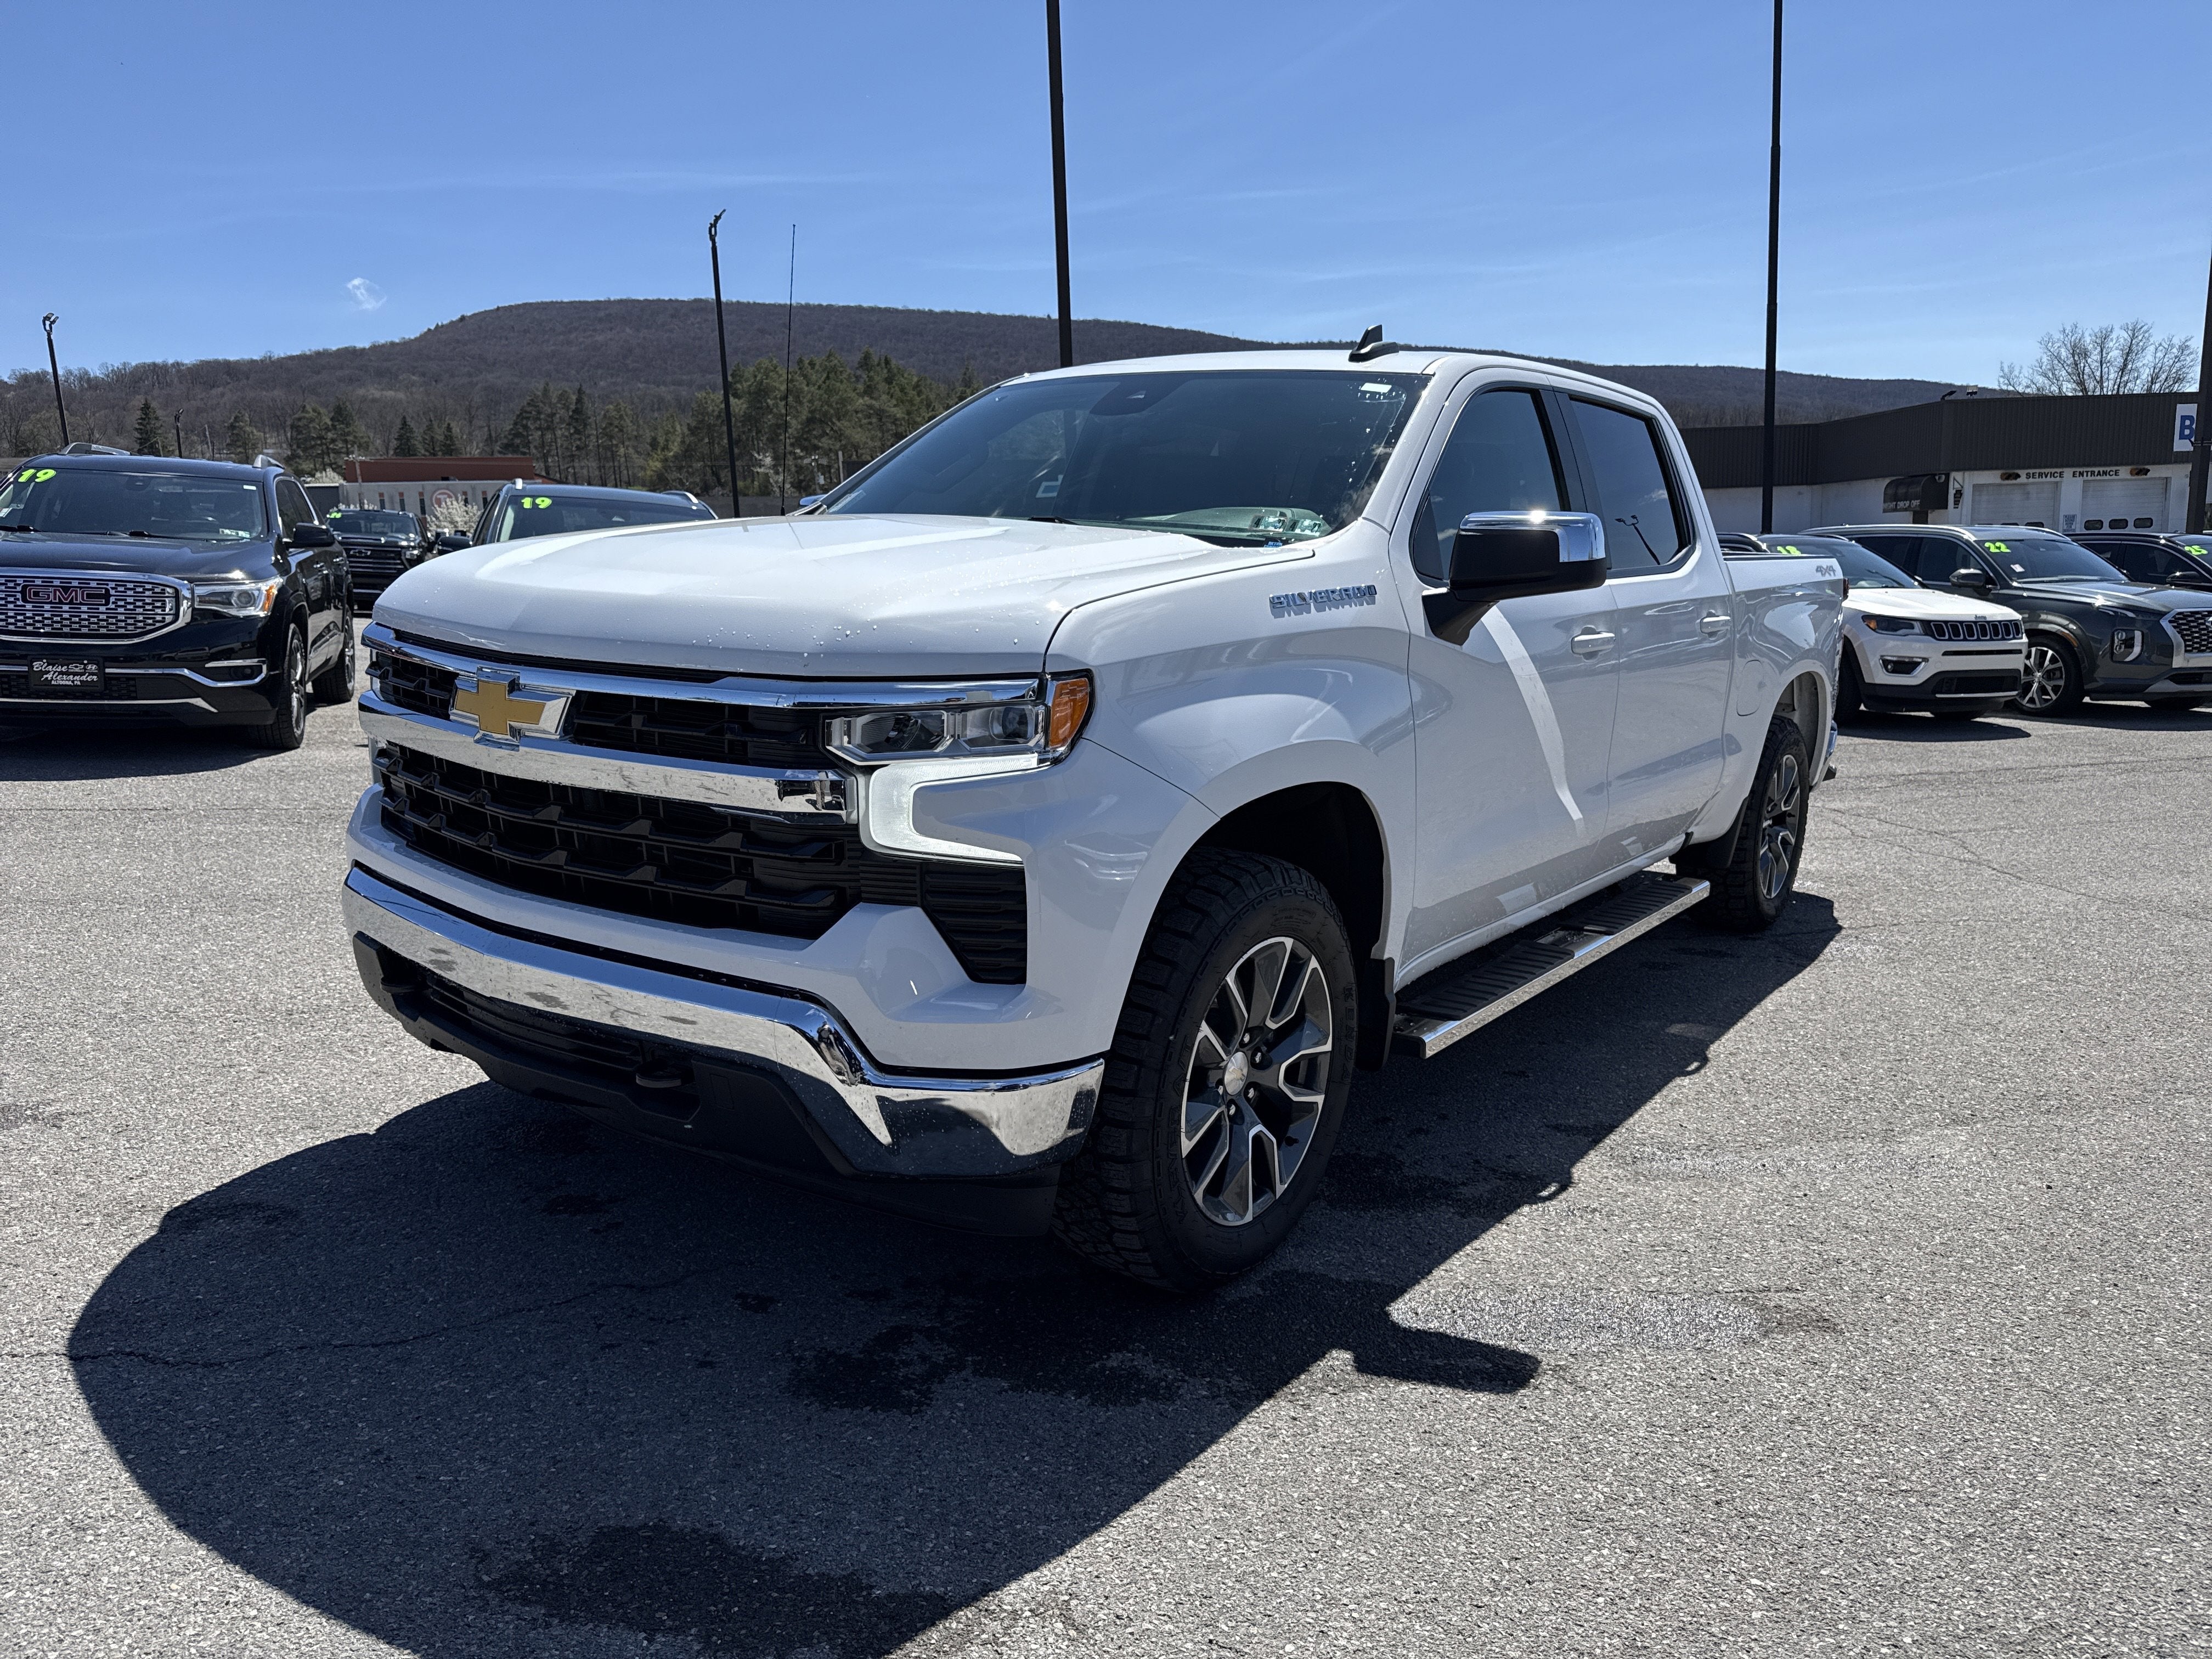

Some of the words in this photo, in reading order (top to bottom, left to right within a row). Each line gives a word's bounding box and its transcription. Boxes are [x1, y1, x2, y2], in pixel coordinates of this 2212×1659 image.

[18, 469, 57, 482] 19
[2025, 471, 2064, 479] SERVICE
[2072, 469, 2120, 478] ENTRANCE
[521, 497, 552, 509] 19
[1897, 500, 1910, 509] DROP
[1910, 499, 1920, 509] OFF
[1984, 542, 2011, 552] 22
[2185, 545, 2208, 555] 25
[27, 586, 105, 603] GMC
[1269, 584, 1378, 609] SILVERADO
[32, 661, 68, 672] Blaise
[41, 671, 98, 681] Alexander
[1342, 986, 1356, 1081] KENDA
